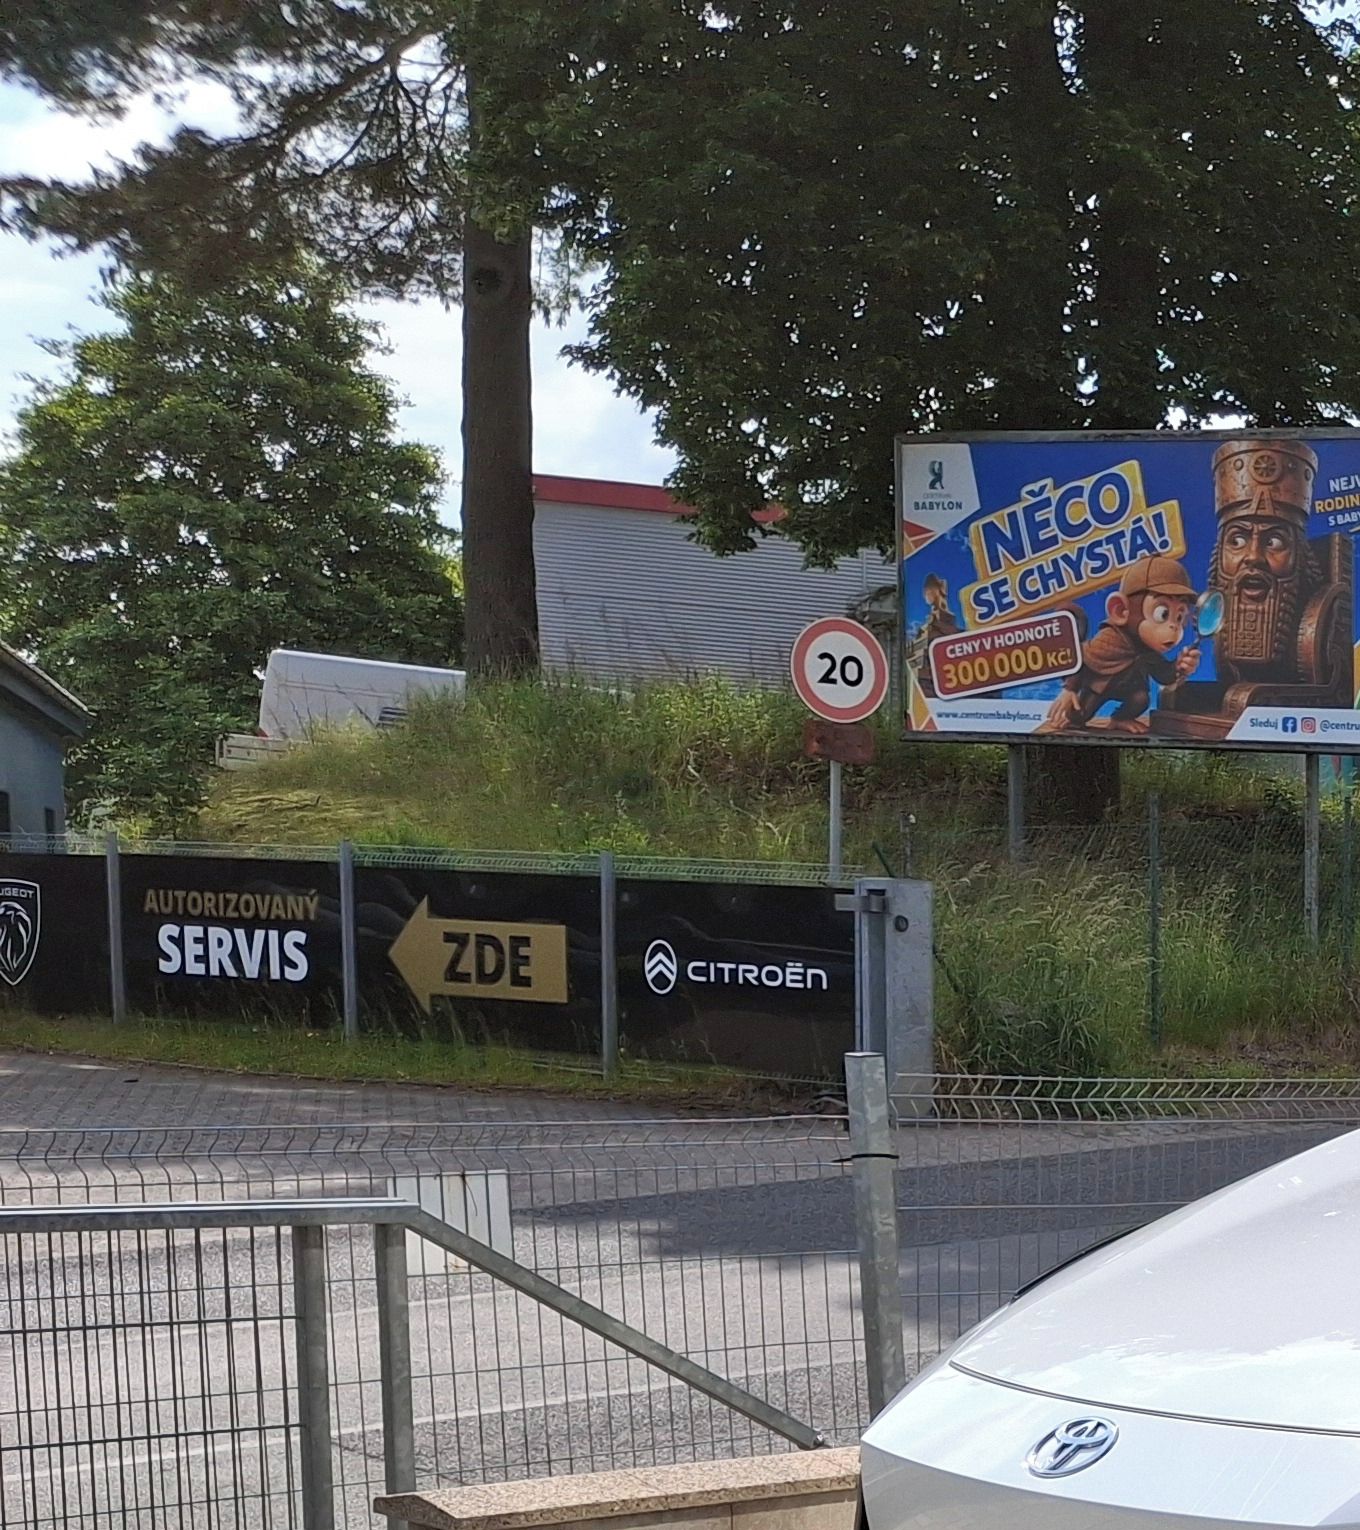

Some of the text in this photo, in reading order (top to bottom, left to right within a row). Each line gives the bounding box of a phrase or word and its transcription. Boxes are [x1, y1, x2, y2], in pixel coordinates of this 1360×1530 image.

[913, 501, 963, 511] BABYLON
[980, 471, 1130, 574] NĚCO
[1328, 515, 1336, 527] S
[971, 511, 1171, 621] SE CHYSTÁ!
[946, 619, 1062, 659] CENY V HODNOTĚ
[817, 652, 864, 688] 20
[942, 656, 991, 689] 300
[993, 645, 1044, 678] 000
[936, 710, 1043, 722] www.centrumbabylon.cz
[1250, 717, 1279, 730] Sleduj
[0, 887, 35, 899] UGEOT
[143, 887, 320, 921] AUTORIZOVANÝ
[157, 924, 309, 982] SERVIS
[442, 930, 532, 988] ZDE
[686, 962, 829, 991] CITROËN
